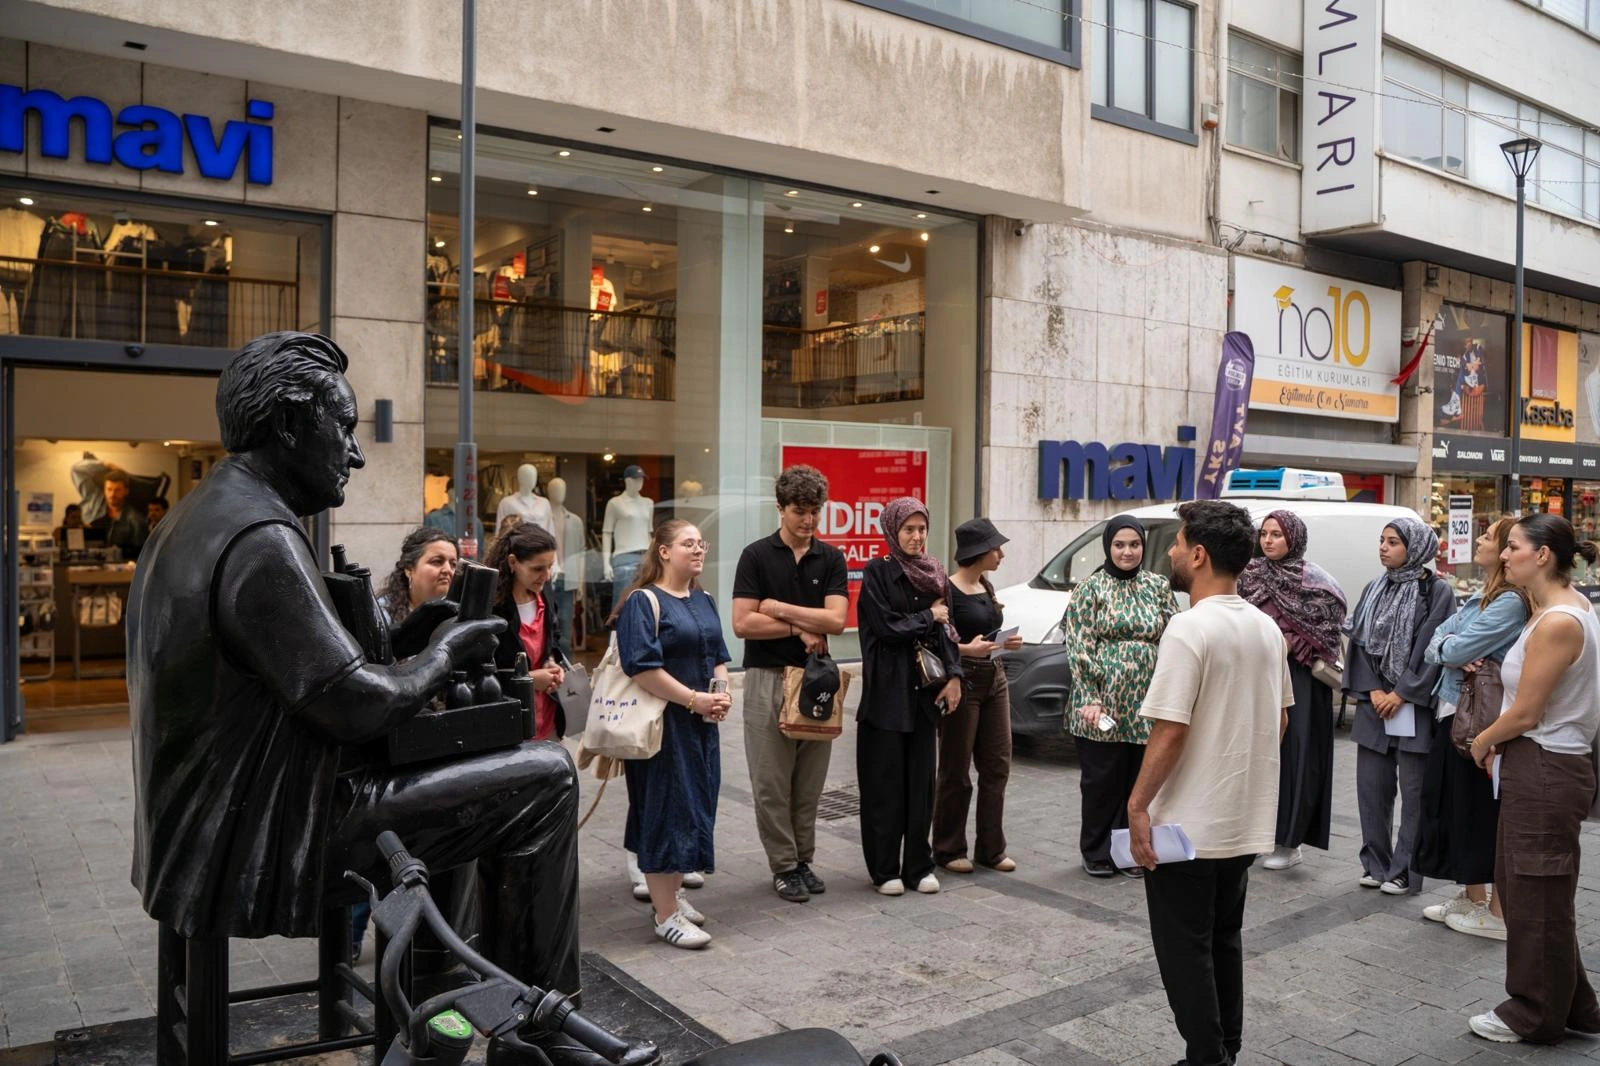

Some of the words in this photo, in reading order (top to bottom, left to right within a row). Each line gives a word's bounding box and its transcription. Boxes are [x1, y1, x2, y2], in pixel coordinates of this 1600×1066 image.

[0, 84, 274, 186] mavi
[1278, 286, 1371, 367] no10
[1280, 386, 1315, 406] Eğitimde
[1317, 371, 1371, 388] KURUMLARI
[1520, 397, 1573, 426] Kasaba
[1038, 425, 1196, 500] mavi
[1204, 439, 1226, 485] YKS
[1452, 520, 1469, 535] %20
